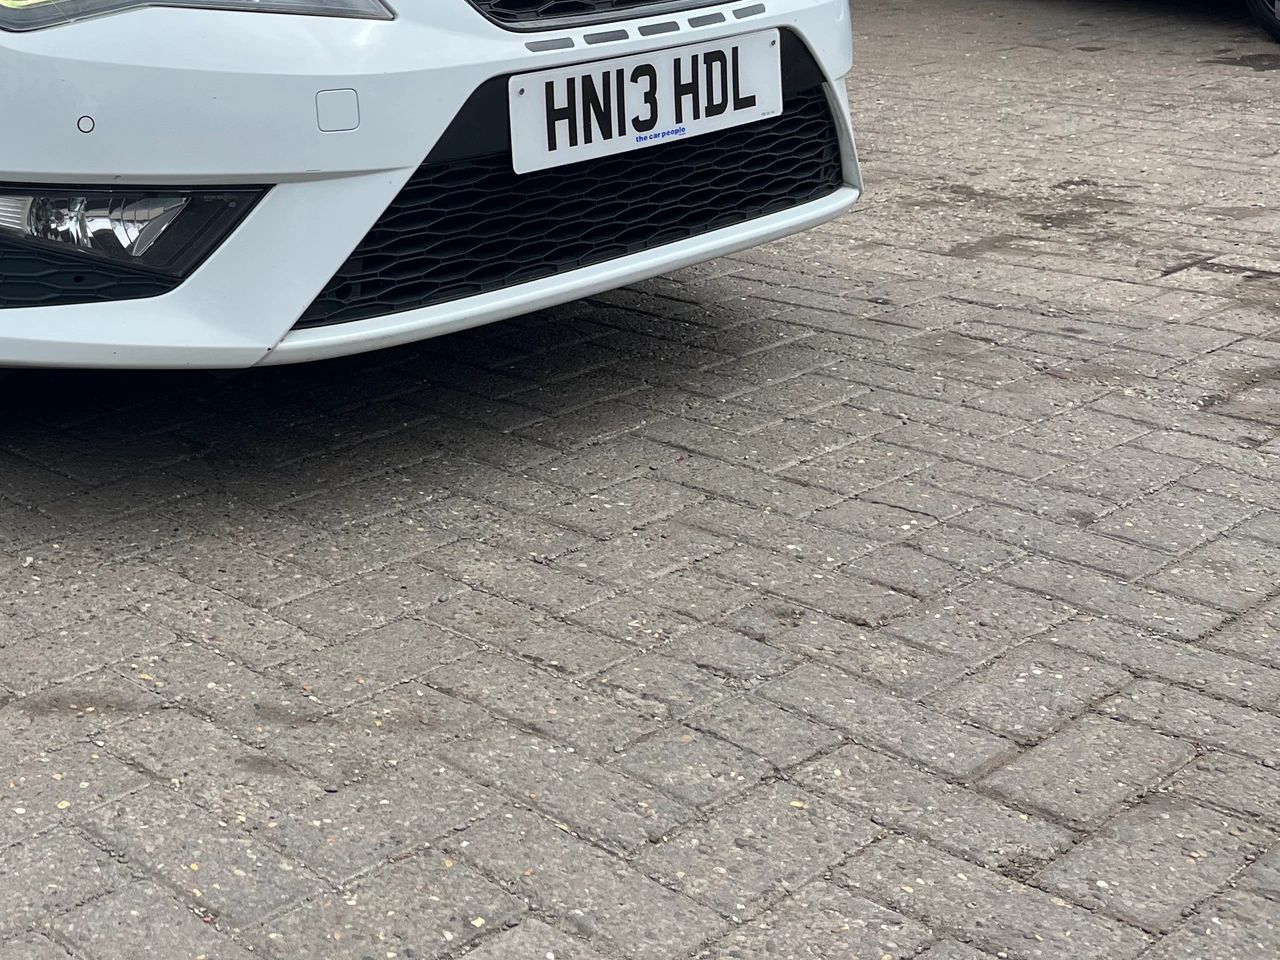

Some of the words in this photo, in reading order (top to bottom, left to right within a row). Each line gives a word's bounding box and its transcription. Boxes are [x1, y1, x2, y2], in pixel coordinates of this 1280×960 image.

[544, 63, 658, 152] HN13
[672, 46, 757, 125] HDL
[635, 134, 648, 143] the
[648, 132, 661, 140] car
[661, 126, 686, 138] people
